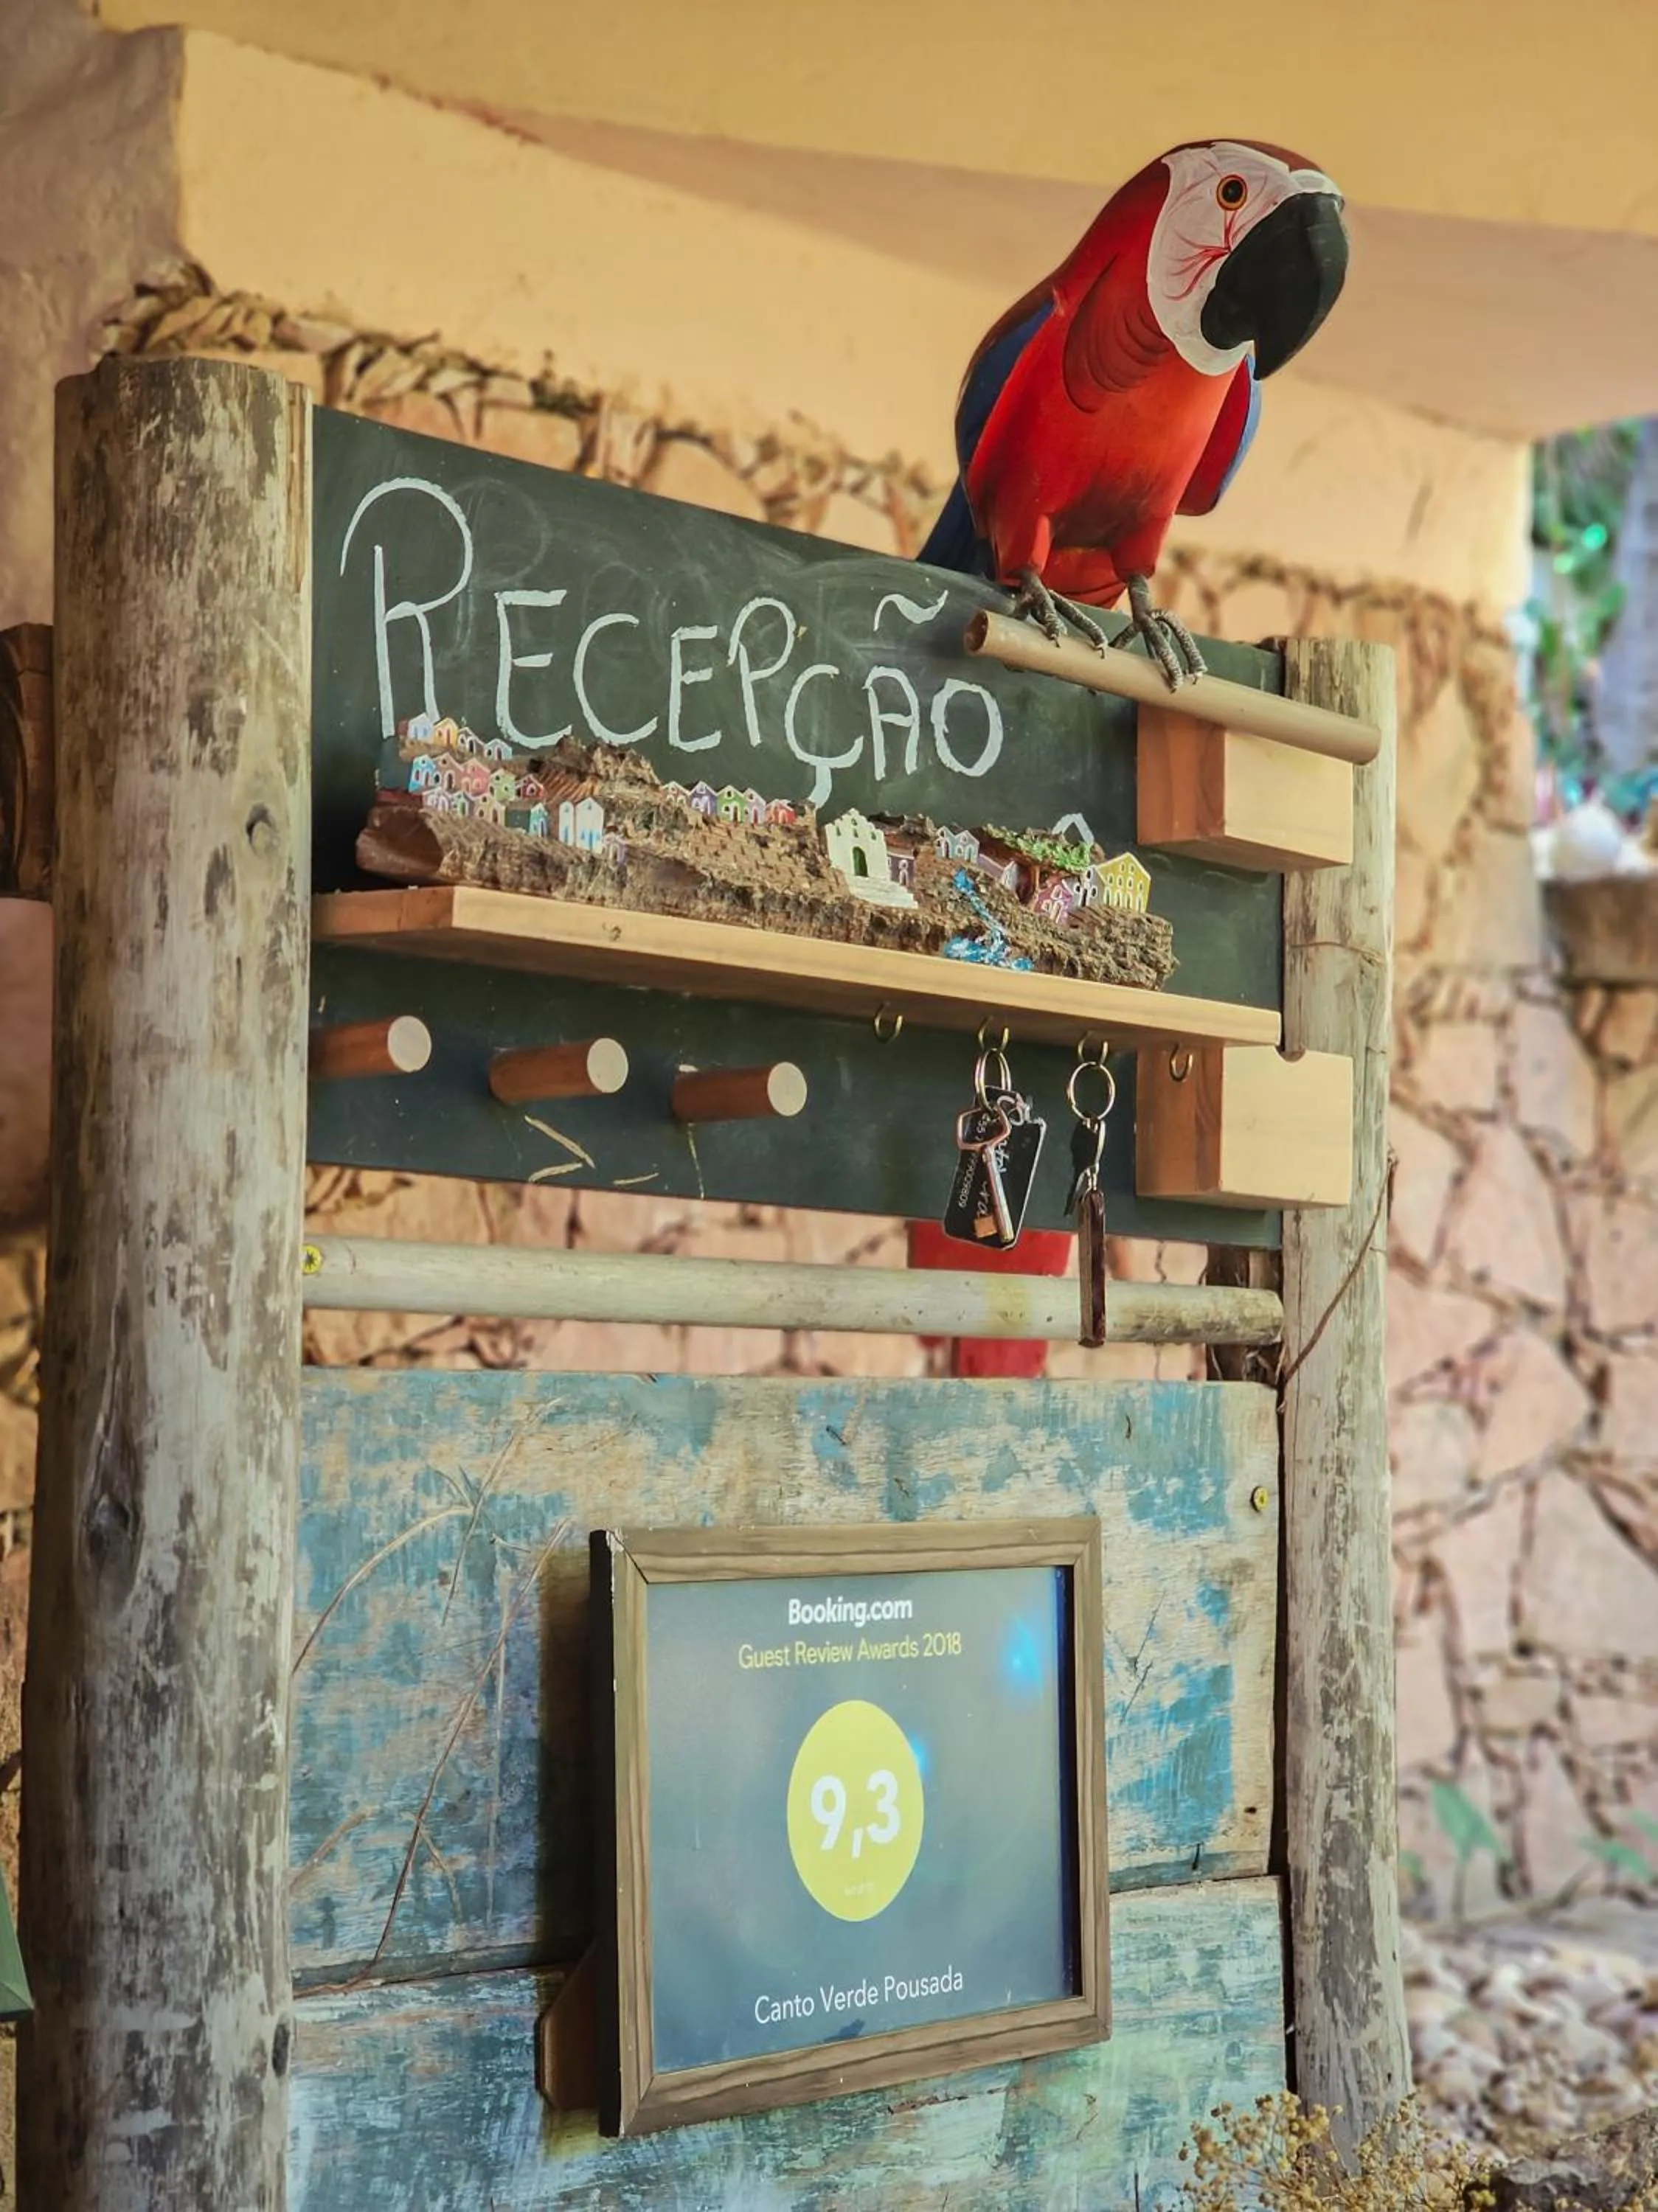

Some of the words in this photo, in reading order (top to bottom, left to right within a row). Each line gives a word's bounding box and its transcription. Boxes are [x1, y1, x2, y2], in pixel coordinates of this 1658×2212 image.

[340, 477, 1003, 809] RECEPÇÃO
[788, 1596, 913, 1627] Booking.com
[738, 1644, 790, 1669] Guest
[794, 1641, 853, 1665] Review
[857, 1635, 919, 1660] Awards
[923, 1632, 962, 1656] 2018
[811, 1769, 901, 1858] 9,3
[755, 1994, 815, 2024] Canto
[820, 1978, 879, 2012] Verde
[884, 1964, 963, 2002] Pousada
